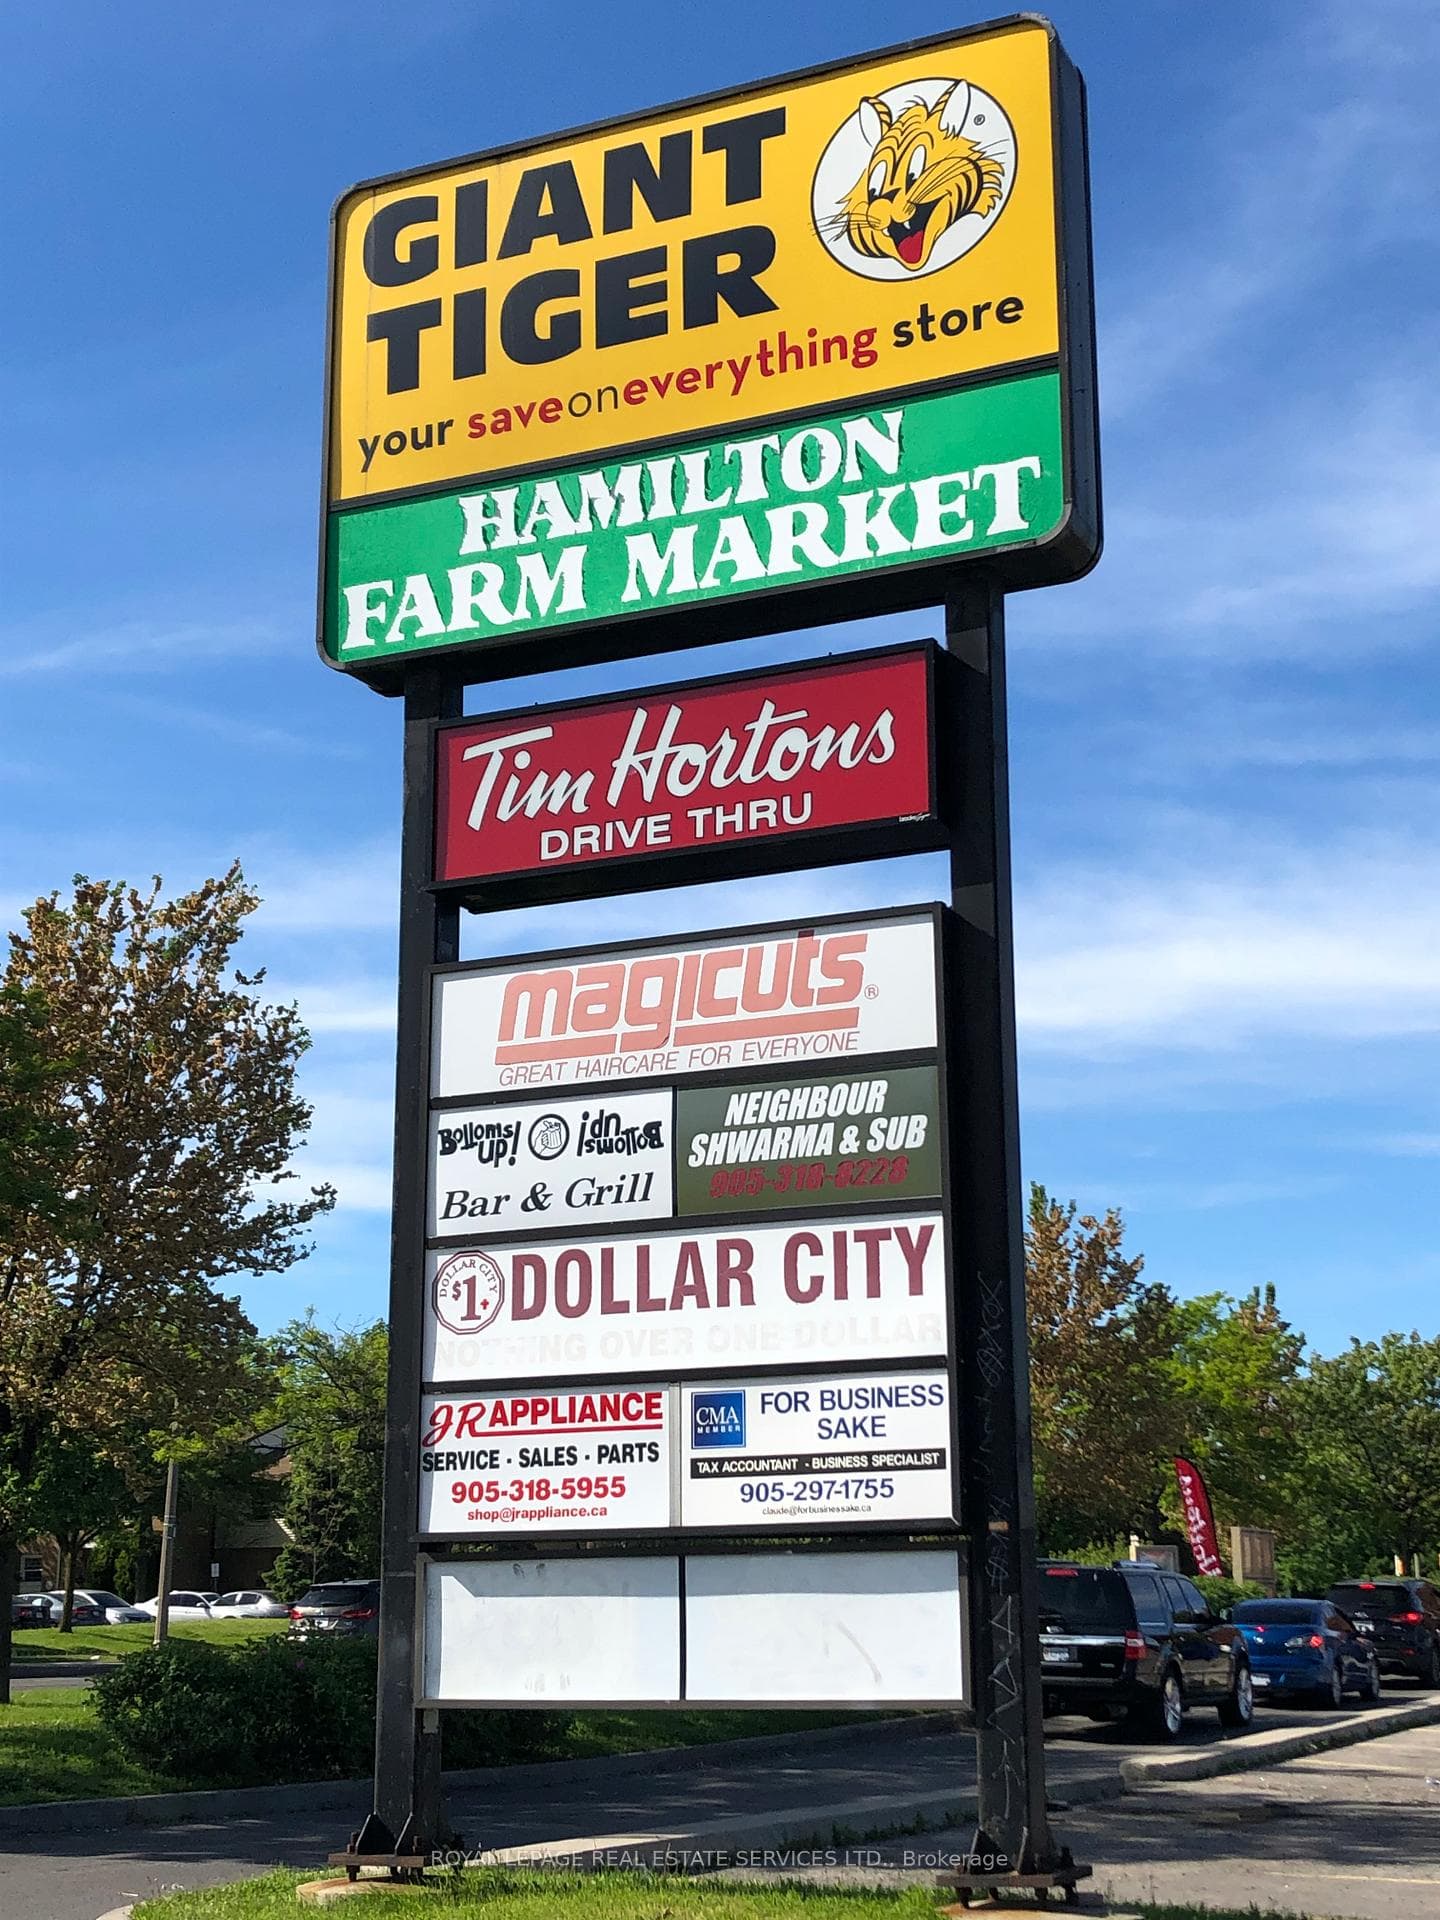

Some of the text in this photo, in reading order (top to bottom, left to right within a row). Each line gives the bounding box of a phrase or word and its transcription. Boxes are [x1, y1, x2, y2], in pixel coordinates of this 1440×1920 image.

[363, 106, 786, 288] GIANT
[366, 223, 779, 394] TIGER
[358, 413, 455, 473] your
[892, 291, 1025, 349] store
[458, 408, 906, 556] HAMILTON
[341, 454, 1042, 651] FARM MARKET
[462, 698, 896, 831] Tim Hortons
[539, 792, 813, 861] DRIVE THRU
[499, 1030, 860, 1087] GREAT HAIRCARE FOR EVERYONE
[724, 1079, 889, 1127] NEIGHBOUR
[688, 1114, 929, 1168] SHWARMA & SUB
[439, 1172, 654, 1220] Bar & Grill
[440, 1259, 498, 1298] DOLLAR CITY
[511, 1224, 936, 1322] DOLLAR CITY
[601, 1326, 695, 1358] OVER
[706, 1323, 781, 1352] ONE
[793, 1313, 943, 1348] DOLLAR
[488, 1392, 663, 1428] APPLIANCE
[696, 1406, 739, 1425] CMA
[760, 1383, 944, 1414] FOR BUSINESS
[817, 1416, 886, 1440] SAKE
[422, 1449, 500, 1473] SERVICE
[519, 1445, 578, 1468] SALES
[598, 1442, 660, 1464] PARTS
[697, 1461, 719, 1473] TAX
[722, 1458, 798, 1472] ACCOUNTANT
[812, 1455, 868, 1469] BUSINESS
[872, 1452, 939, 1467] SPECIALIST
[451, 1476, 626, 1504] 905-318-5955
[467, 1505, 608, 1523] shop@jrappliance.ca
[740, 1478, 895, 1504] 905-297-1755
